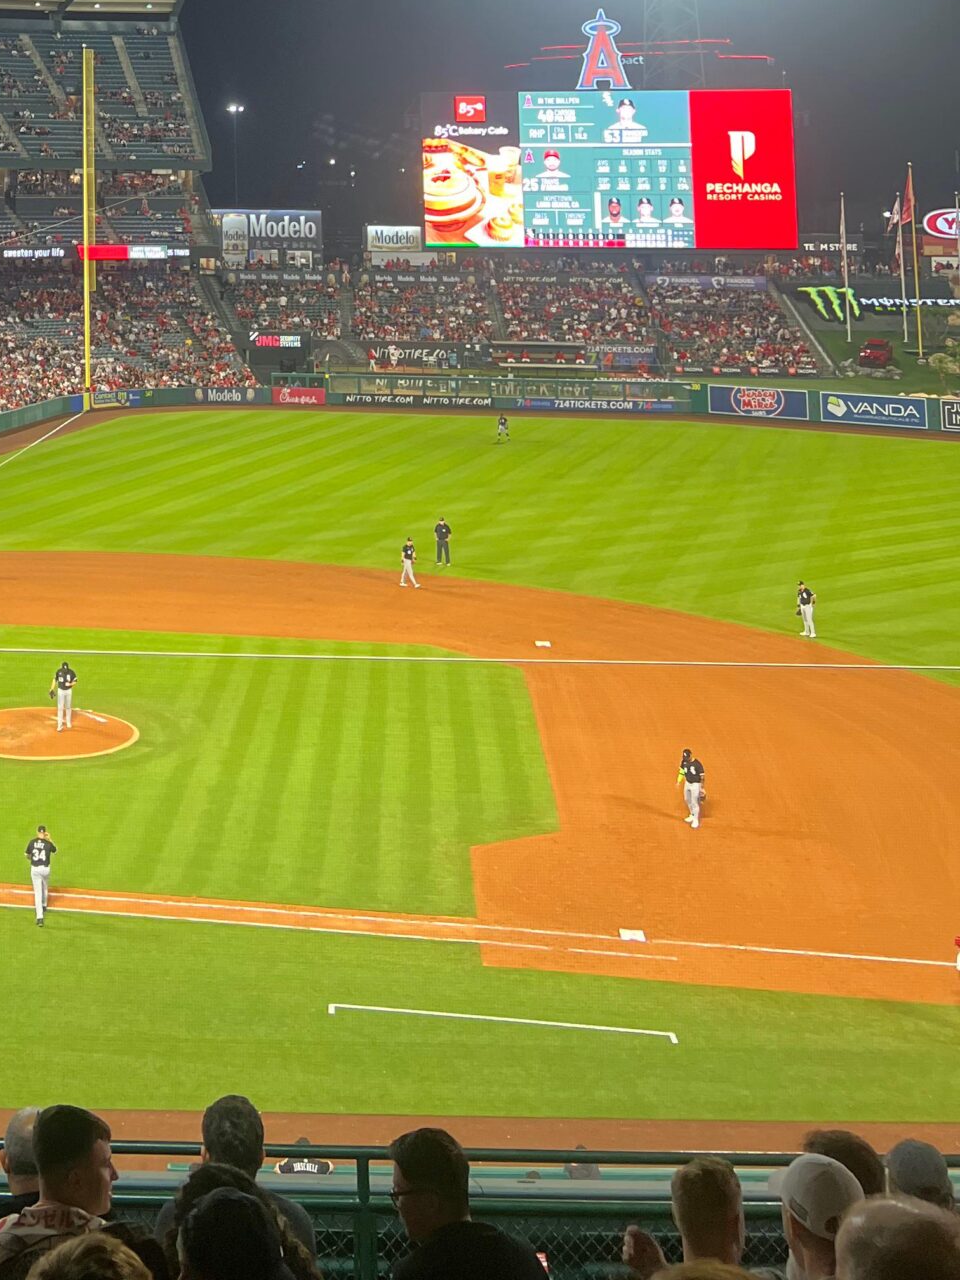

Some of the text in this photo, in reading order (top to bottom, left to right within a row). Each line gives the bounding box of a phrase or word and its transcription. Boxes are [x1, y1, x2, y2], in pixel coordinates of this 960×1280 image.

[459, 126, 488, 136] Bakery
[522, 178, 539, 191] 25
[706, 183, 781, 193] PECHANGA
[249, 214, 316, 238] Modelo
[375, 229, 415, 244] Modelo
[3, 247, 65, 259] sweeten your life
[803, 243, 828, 251] TEM
[255, 335, 280, 347] JMG
[208, 389, 241, 401] Modelo
[346, 395, 413, 404] NITTO TIRE.COM
[738, 388, 777, 401] Jersey
[423, 397, 491, 407] NITTO TIRE.COM
[554, 400, 632, 409] 714TICKETS.COM
[848, 401, 919, 417] VANDA
[32, 849, 46, 861] 34
